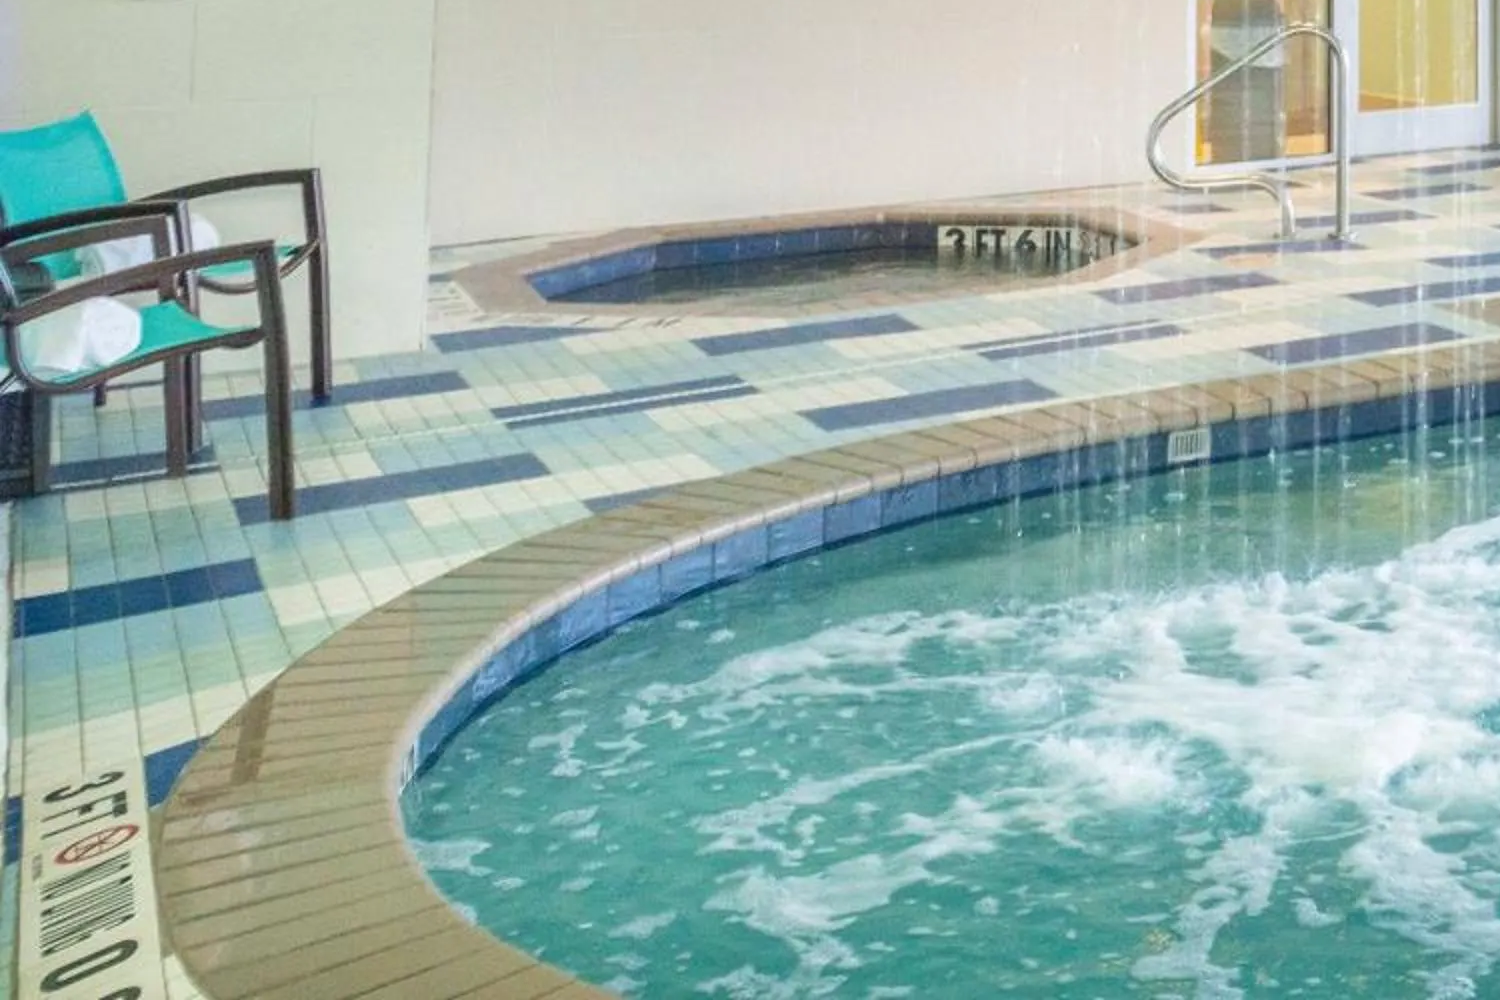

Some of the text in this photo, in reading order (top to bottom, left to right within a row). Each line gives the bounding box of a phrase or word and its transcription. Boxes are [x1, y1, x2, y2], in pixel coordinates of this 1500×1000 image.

[945, 227, 967, 251] 3
[975, 229, 1006, 253] FT
[1014, 229, 1037, 252] 6
[1045, 230, 1071, 254] IN
[43, 770, 125, 803] 3
[41, 790, 128, 840] FT
[40, 850, 131, 901] NO
[39, 874, 135, 957] DIVING
